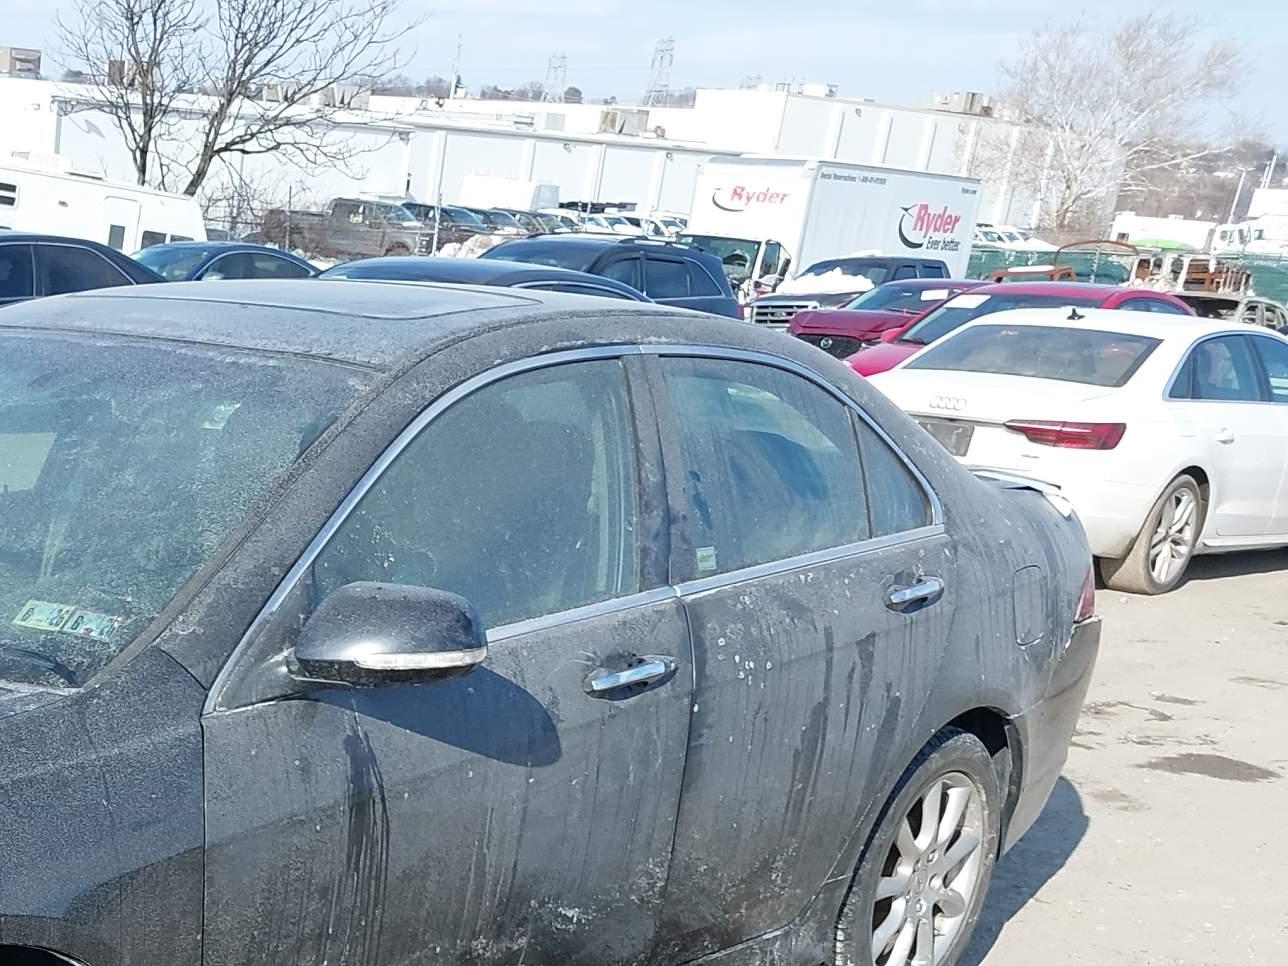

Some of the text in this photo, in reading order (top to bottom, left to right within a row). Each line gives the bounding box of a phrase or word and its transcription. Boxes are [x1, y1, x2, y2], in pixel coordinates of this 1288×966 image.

[730, 185, 790, 206] Ryder
[912, 203, 961, 239] Ryder
[925, 235, 942, 250] Ever
